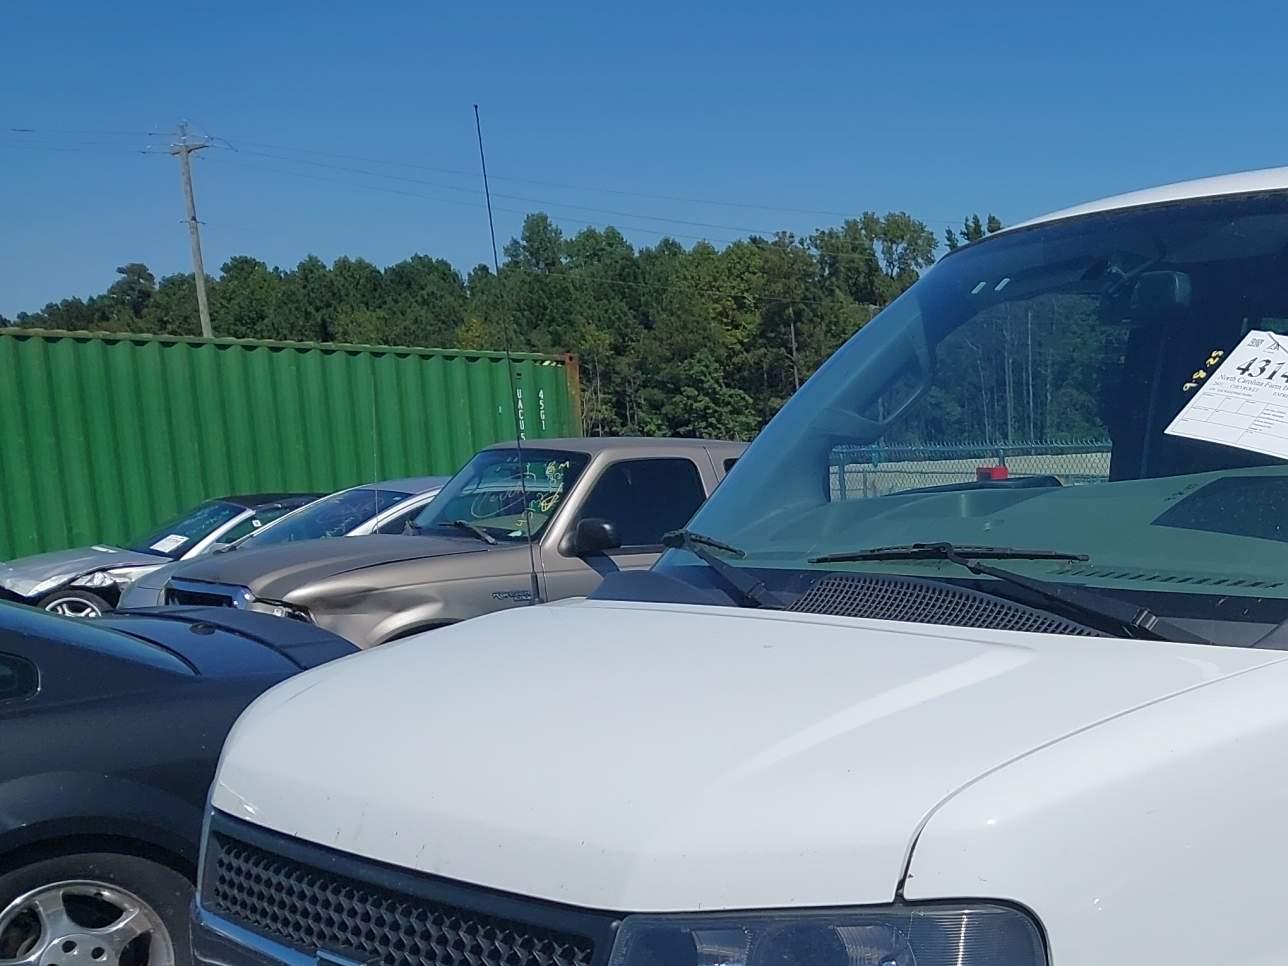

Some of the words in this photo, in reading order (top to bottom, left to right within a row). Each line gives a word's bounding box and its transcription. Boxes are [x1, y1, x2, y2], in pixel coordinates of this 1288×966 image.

[1237, 377, 1263, 387] Carolina
[1264, 381, 1282, 390] Farm
[516, 388, 525, 430] UACU
[538, 389, 546, 431] 45G1
